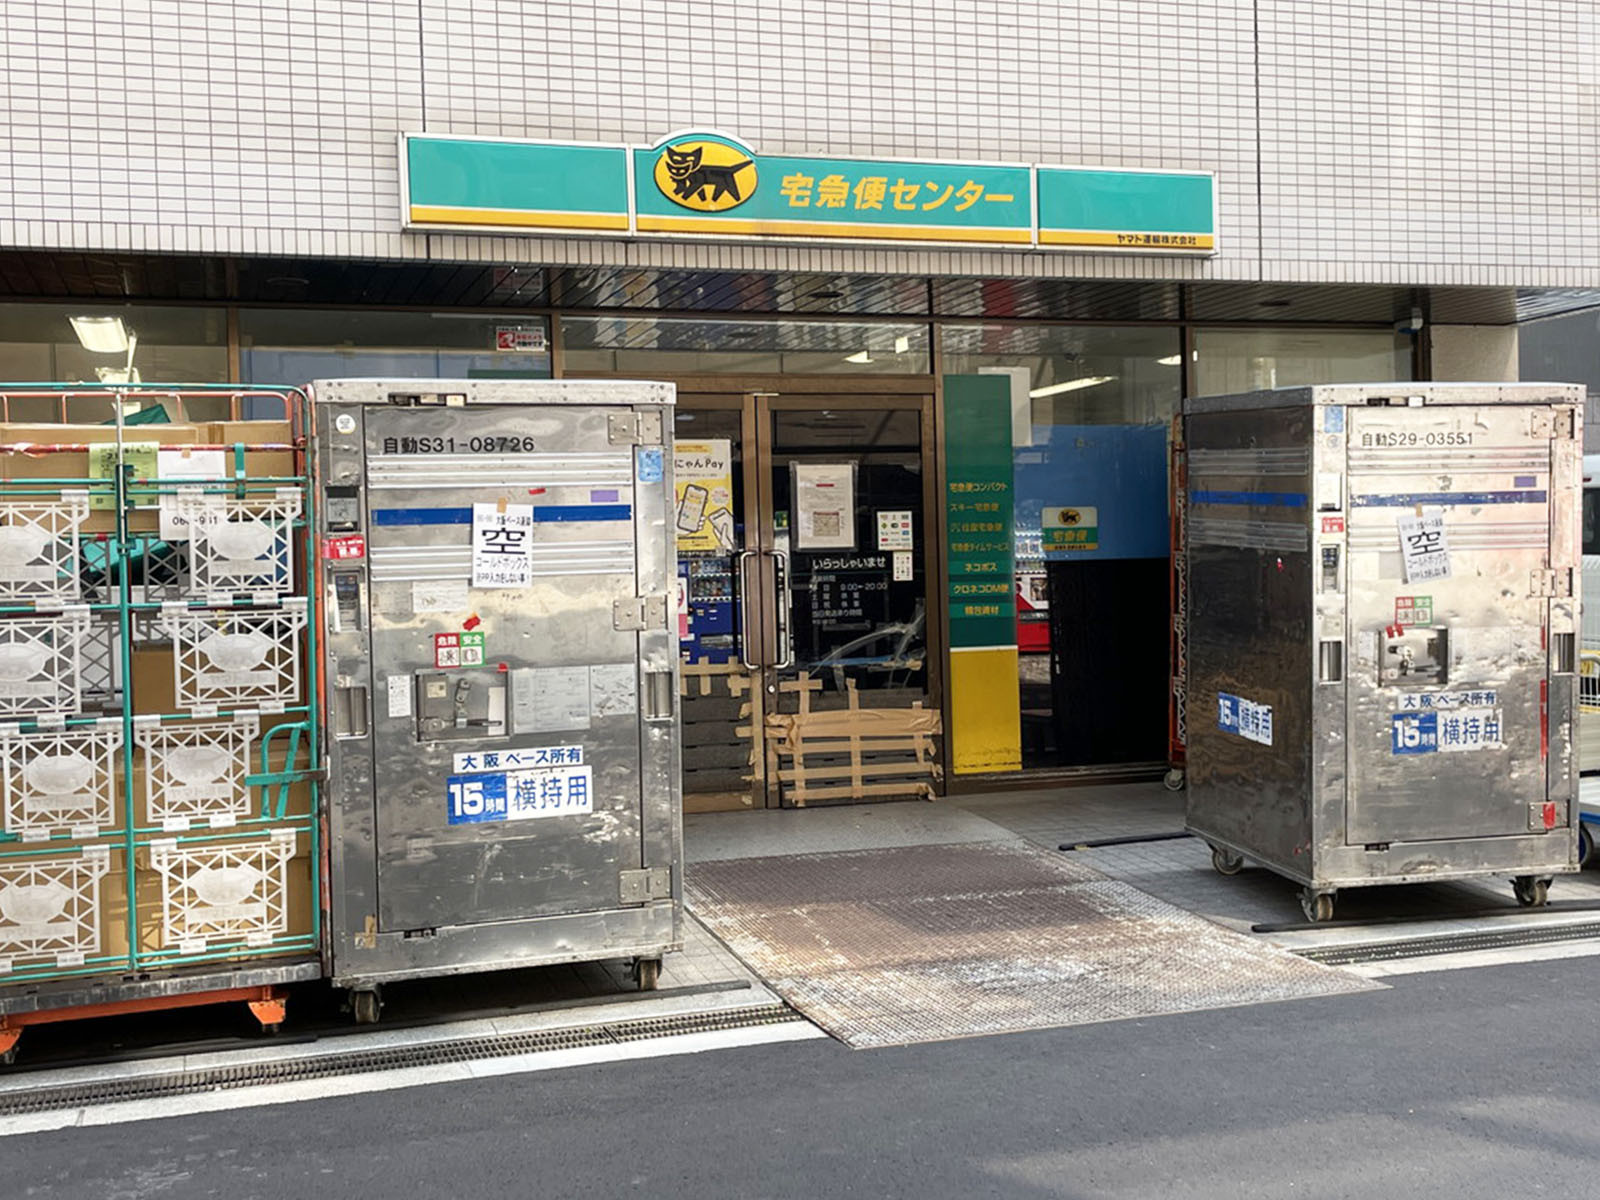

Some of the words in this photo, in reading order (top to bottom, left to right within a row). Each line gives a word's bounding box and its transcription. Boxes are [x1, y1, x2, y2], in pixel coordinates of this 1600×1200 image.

[780, 172, 1014, 212] 宅急便センター
[1117, 234, 1197, 245] ヤマト運輸株式会社
[384, 436, 534, 454] 自動S31-08726
[1362, 431, 1473, 446] 自動S29-03551
[481, 527, 526, 555] 空
[1408, 531, 1444, 557] 空
[812, 558, 885, 568] いらっしゃいませ
[1442, 715, 1500, 745] 横持用
[461, 747, 582, 771] 大阪ベース所有
[510, 775, 588, 812] 横持用
